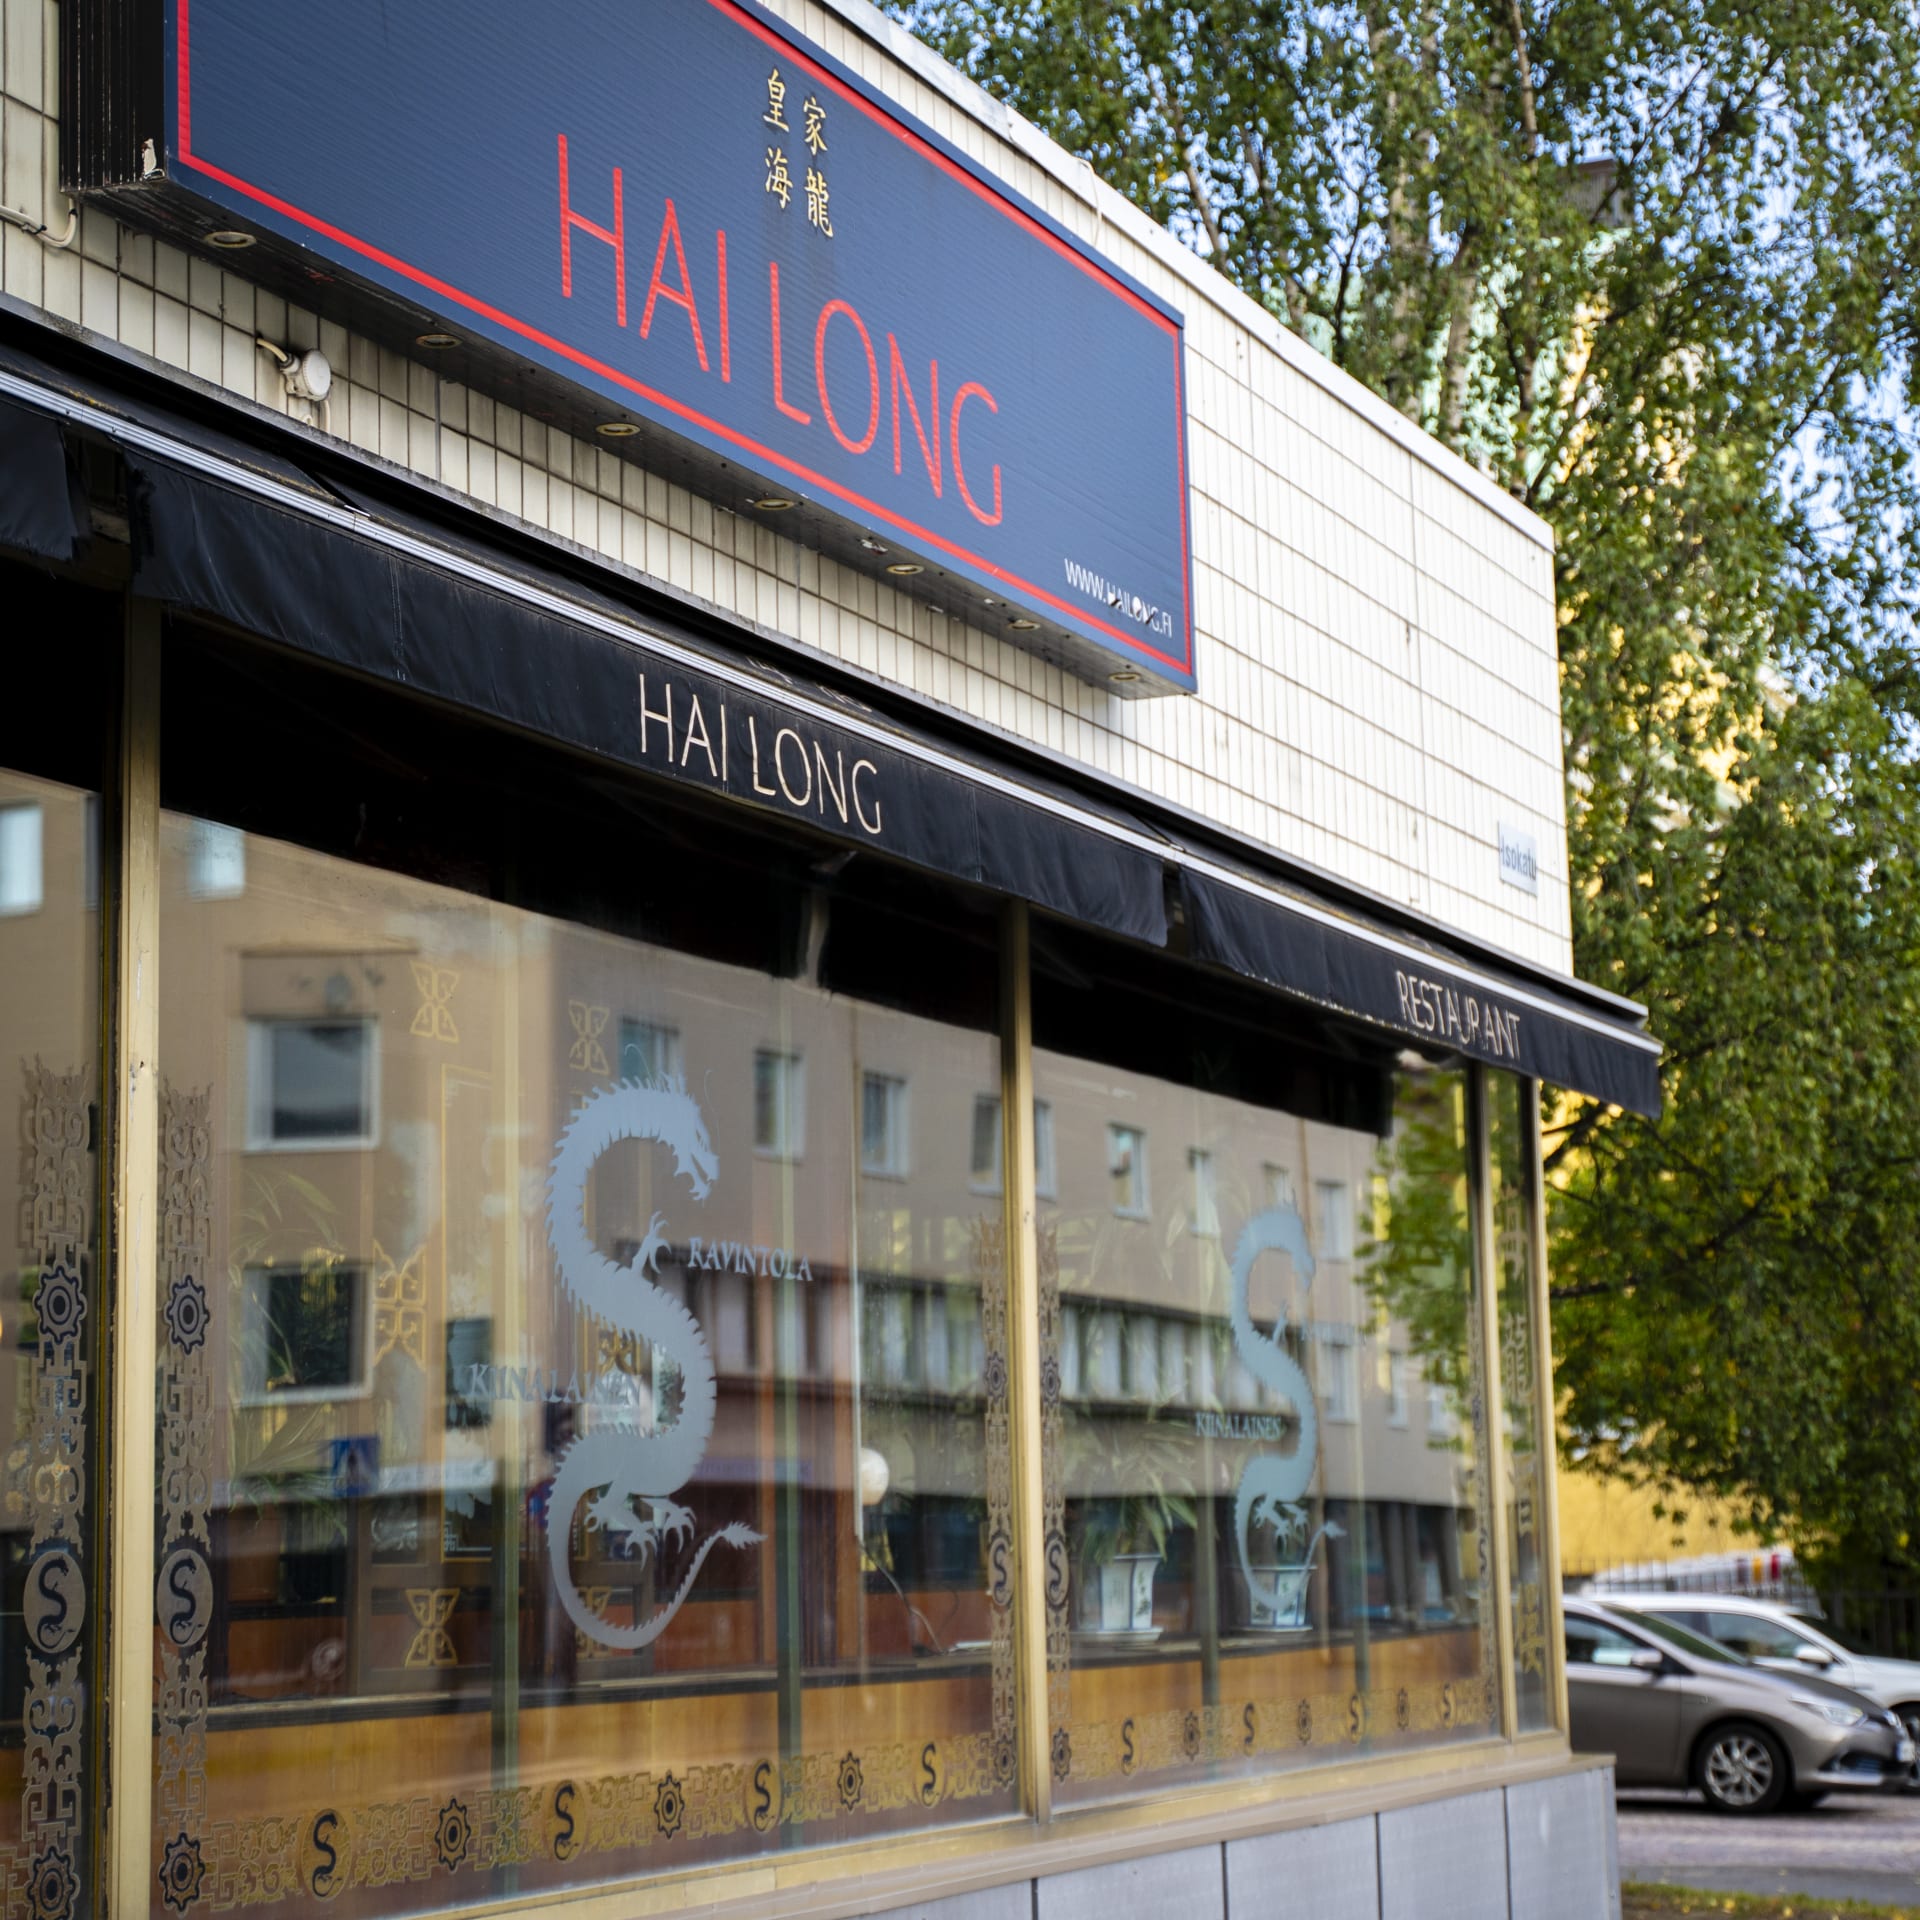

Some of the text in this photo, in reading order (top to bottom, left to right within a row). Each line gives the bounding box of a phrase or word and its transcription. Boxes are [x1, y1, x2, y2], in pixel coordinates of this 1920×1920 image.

[558, 134, 1002, 526] HAI LONG
[639, 673, 881, 834] HAI LONG
[1502, 835, 1537, 881] Isokatu
[1396, 970, 1520, 1060] RESTAURANT
[687, 1236, 813, 1282] RAVINTOLA
